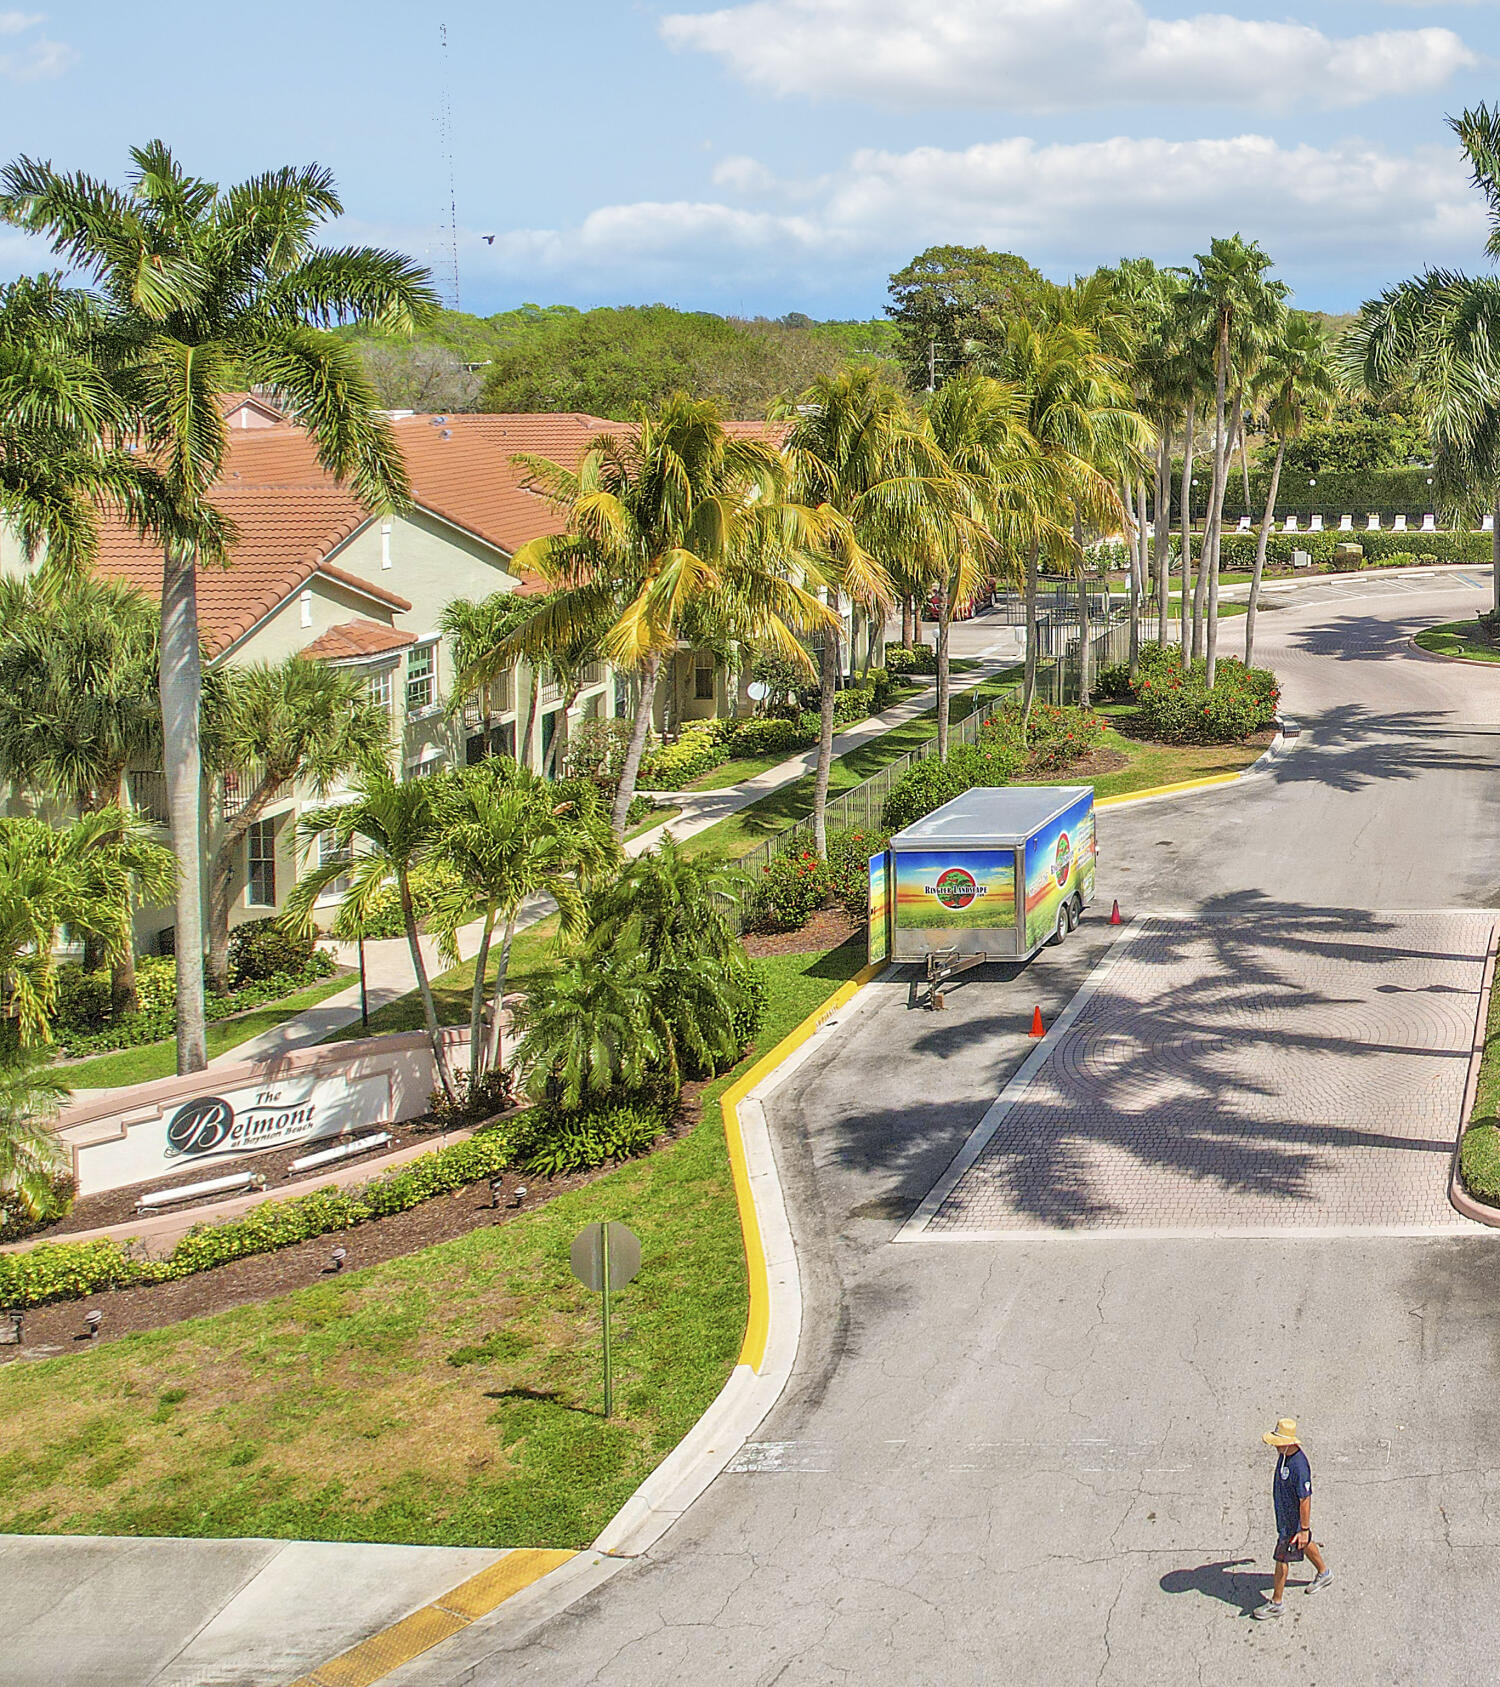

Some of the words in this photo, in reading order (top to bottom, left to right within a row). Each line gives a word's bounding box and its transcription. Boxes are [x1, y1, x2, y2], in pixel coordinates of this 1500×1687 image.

[255, 1091, 282, 1105] The
[164, 1102, 316, 1158] Belmont
[230, 1140, 241, 1148] at
[243, 1131, 282, 1146] Boynton
[284, 1122, 314, 1136] Beach
